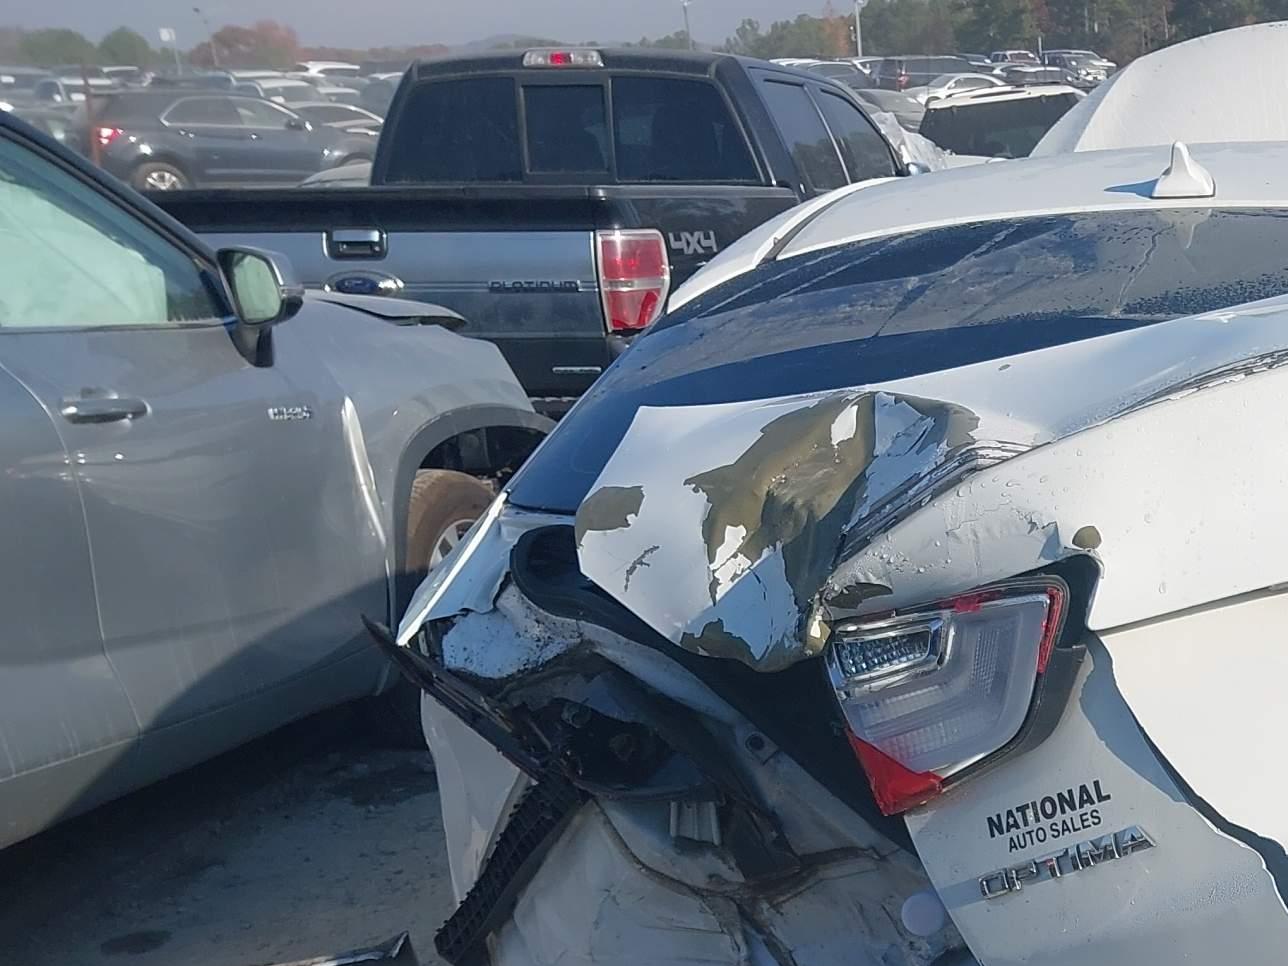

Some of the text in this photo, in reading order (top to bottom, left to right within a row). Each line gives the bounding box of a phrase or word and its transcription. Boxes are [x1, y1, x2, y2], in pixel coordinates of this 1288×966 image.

[488, 280, 580, 294] PLATINUM
[986, 780, 1112, 838] NATIONAL
[1009, 809, 1102, 853] AUTO SALES
[978, 824, 1157, 899] OPTIMA
